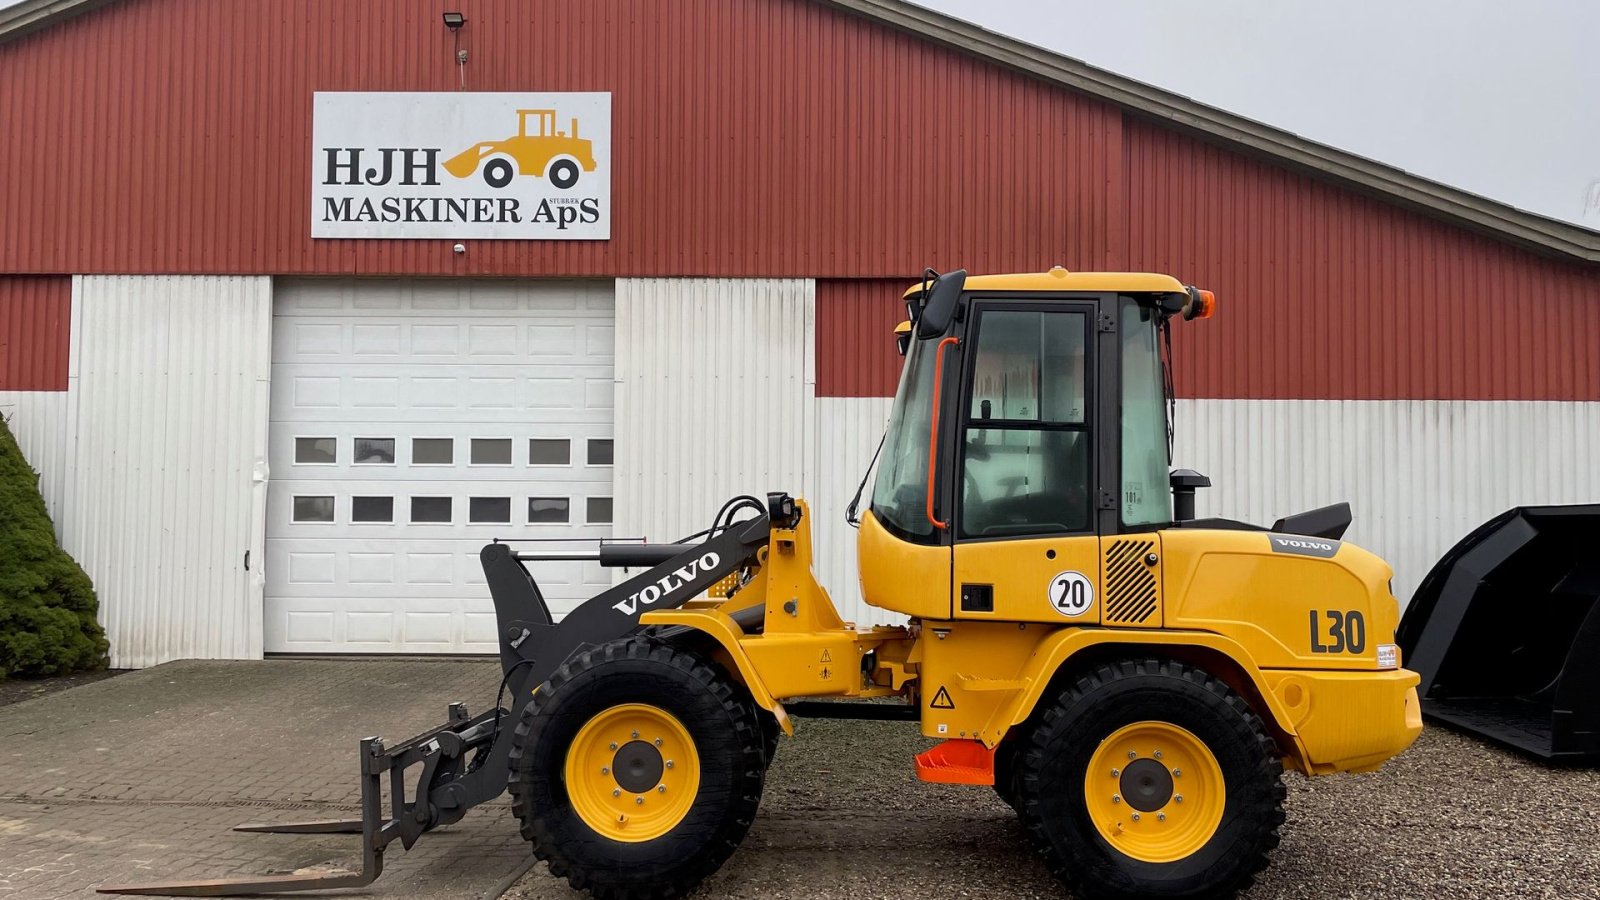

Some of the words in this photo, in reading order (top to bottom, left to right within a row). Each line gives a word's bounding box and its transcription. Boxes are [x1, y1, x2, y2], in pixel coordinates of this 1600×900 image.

[322, 147, 441, 186] HJH
[322, 196, 522, 223] MASKINER
[531, 197, 599, 230] ApS
[1276, 538, 1332, 551] VOLVO
[612, 551, 720, 616] VOLVO
[1057, 579, 1085, 608] 20
[1309, 609, 1365, 654] L30
